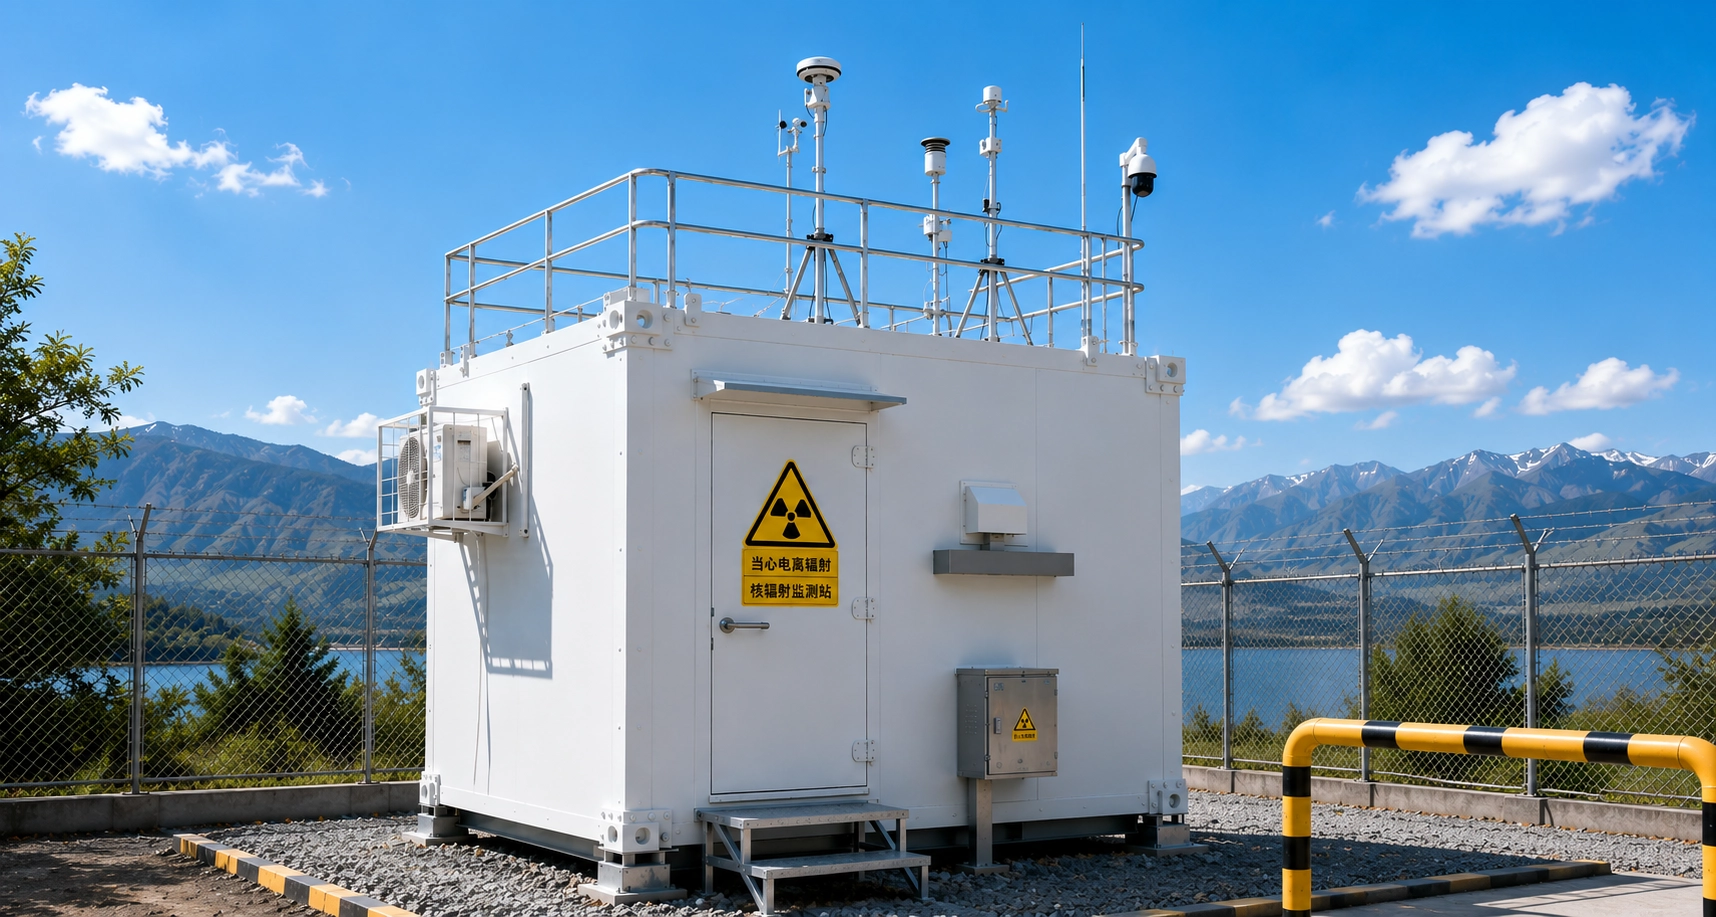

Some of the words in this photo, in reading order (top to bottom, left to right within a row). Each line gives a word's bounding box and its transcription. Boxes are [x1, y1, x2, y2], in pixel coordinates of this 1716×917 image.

[751, 555, 832, 573] 当心电离辐射
[750, 582, 832, 599] 核辐射监测站
